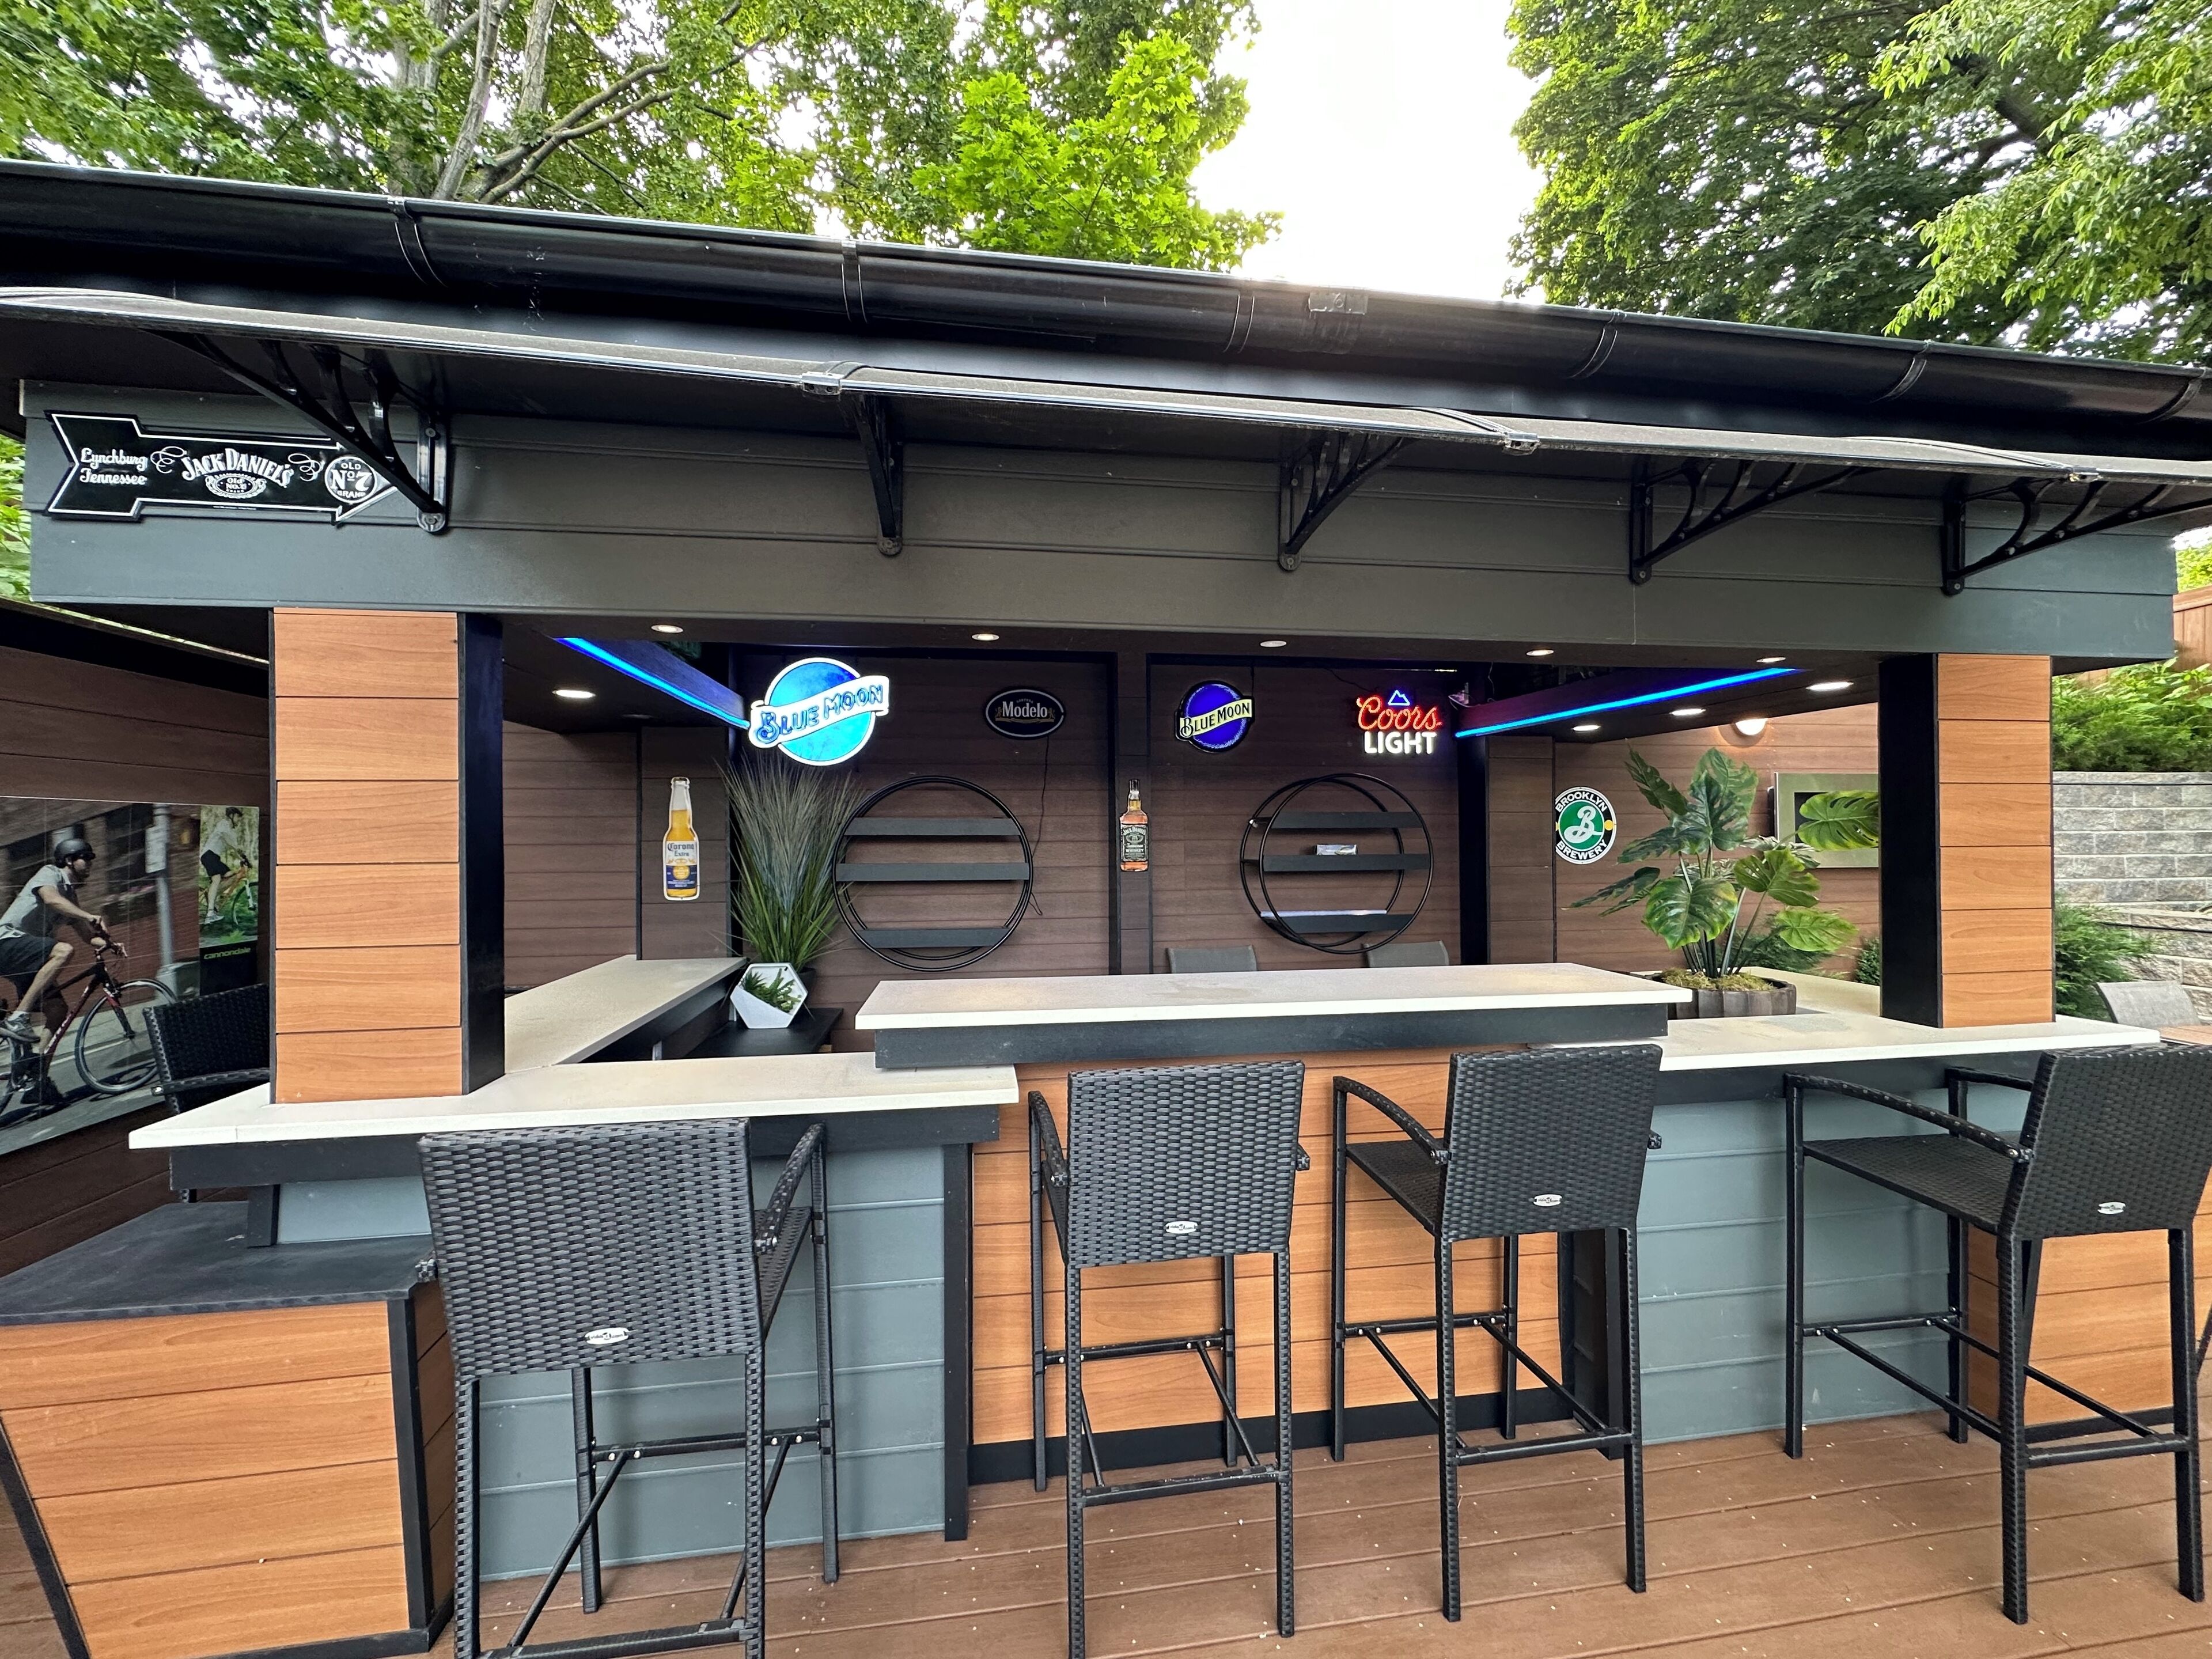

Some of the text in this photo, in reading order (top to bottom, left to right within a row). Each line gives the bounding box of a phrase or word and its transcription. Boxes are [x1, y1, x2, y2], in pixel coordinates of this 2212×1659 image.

[81, 448, 148, 472] Lynchburg
[181, 448, 294, 488] JACK DANIEL'S
[340, 462, 361, 470] OLD
[79, 467, 148, 485] Tennessee
[337, 490, 366, 499] BRAND
[756, 684, 883, 744] BLUE MOON
[1002, 701, 1048, 718] Modelo
[1181, 702, 1249, 737] BLUE MOON
[1356, 695, 1442, 730] Coors
[1364, 731, 1437, 754] LIGHT
[1555, 791, 1608, 813] BROOKLYN
[667, 842, 695, 851] Corona
[1556, 839, 1607, 860] BREWERY
